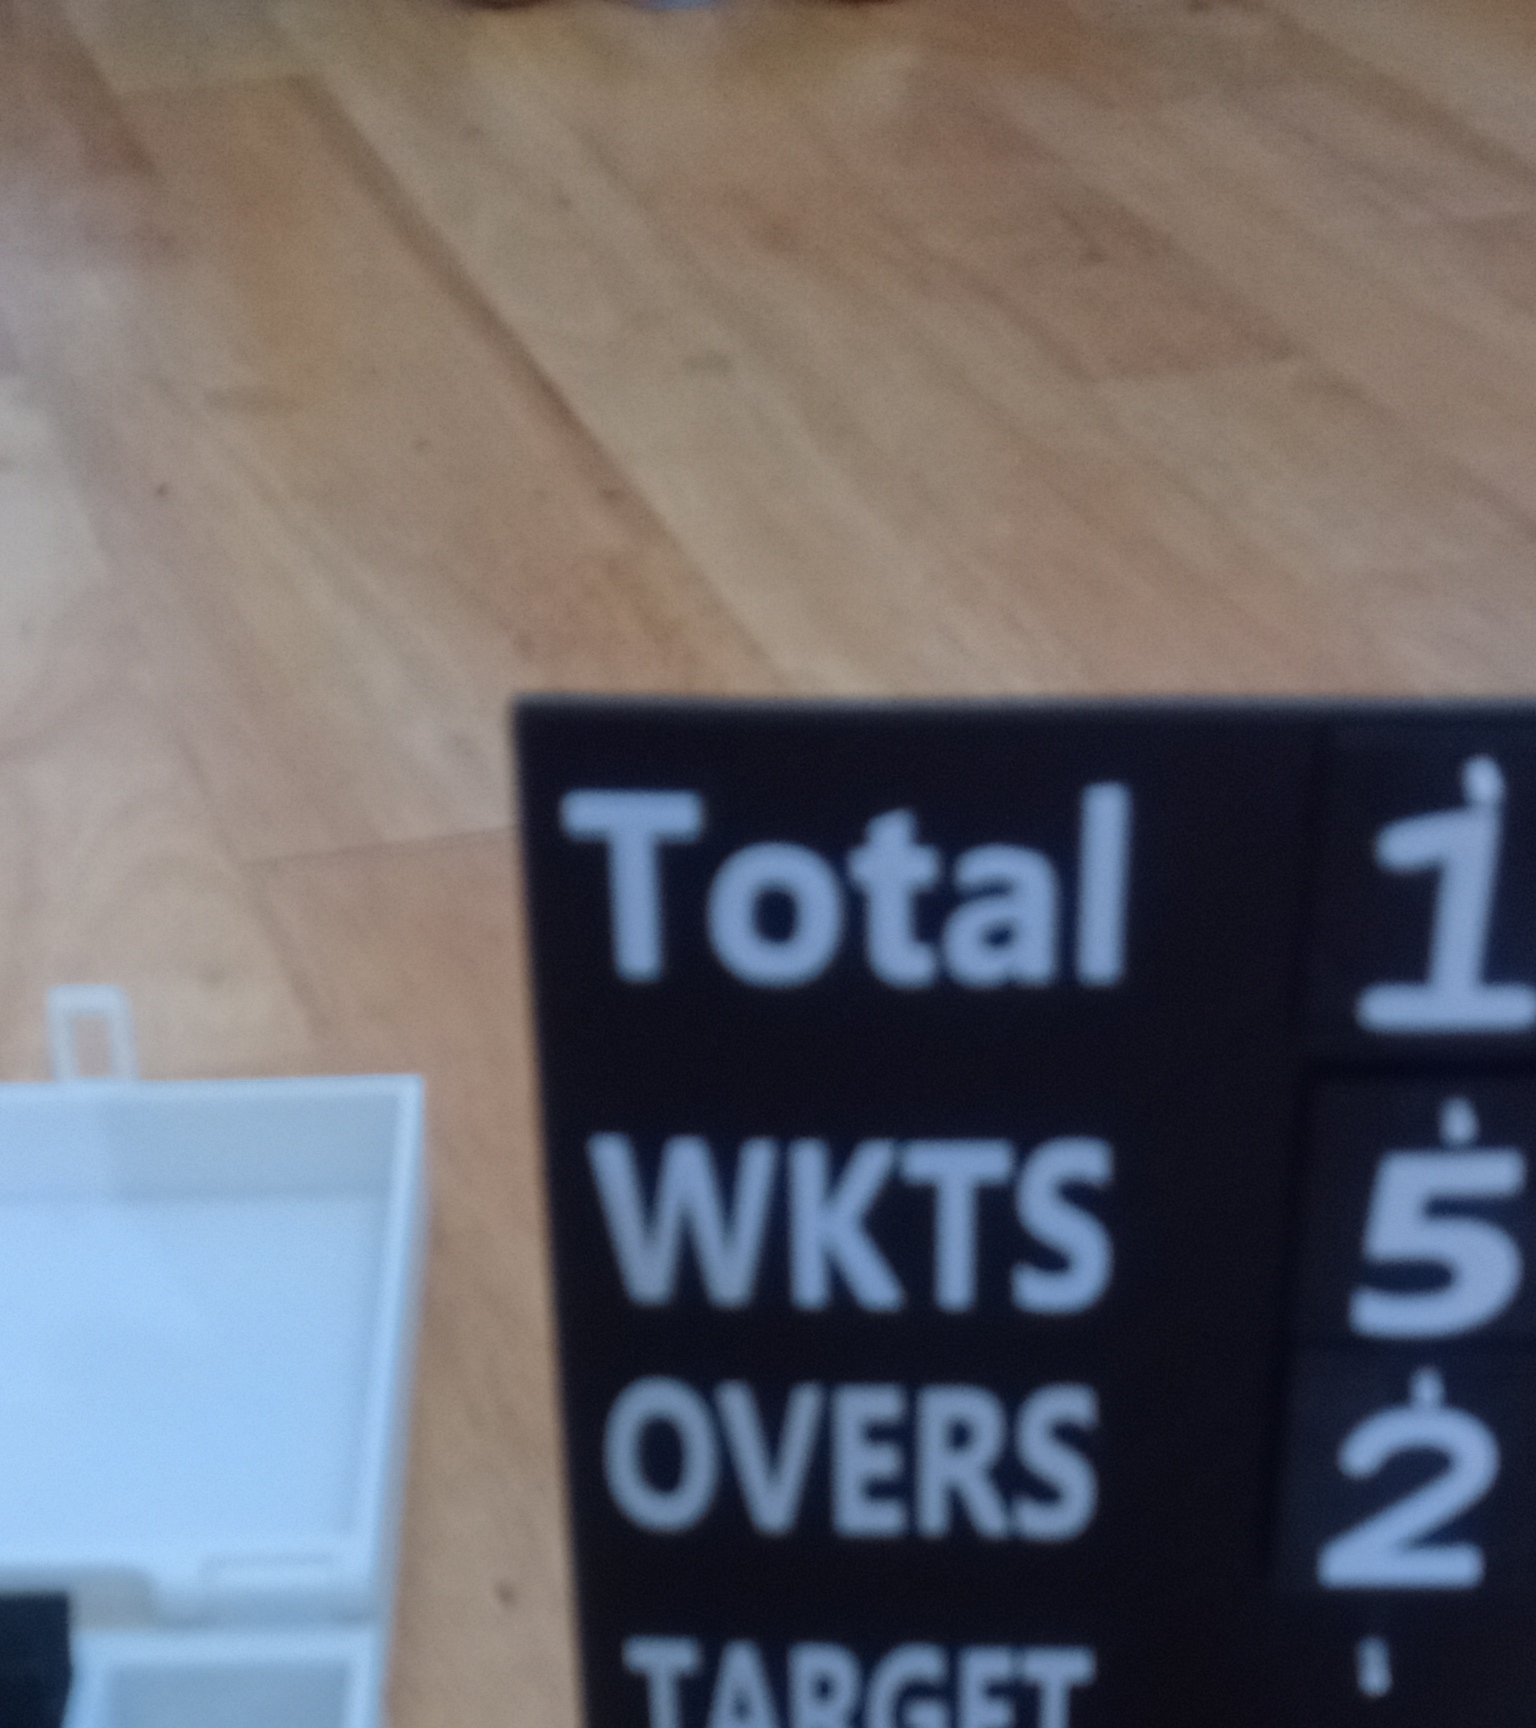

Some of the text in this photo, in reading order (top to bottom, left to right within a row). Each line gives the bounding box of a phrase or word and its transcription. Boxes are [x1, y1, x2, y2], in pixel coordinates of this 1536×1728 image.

[561, 782, 1130, 987] Total
[589, 1133, 1525, 1338] WKTS 5
[604, 1379, 1098, 1541] OVERS
[1317, 1405, 1500, 1590] 2
